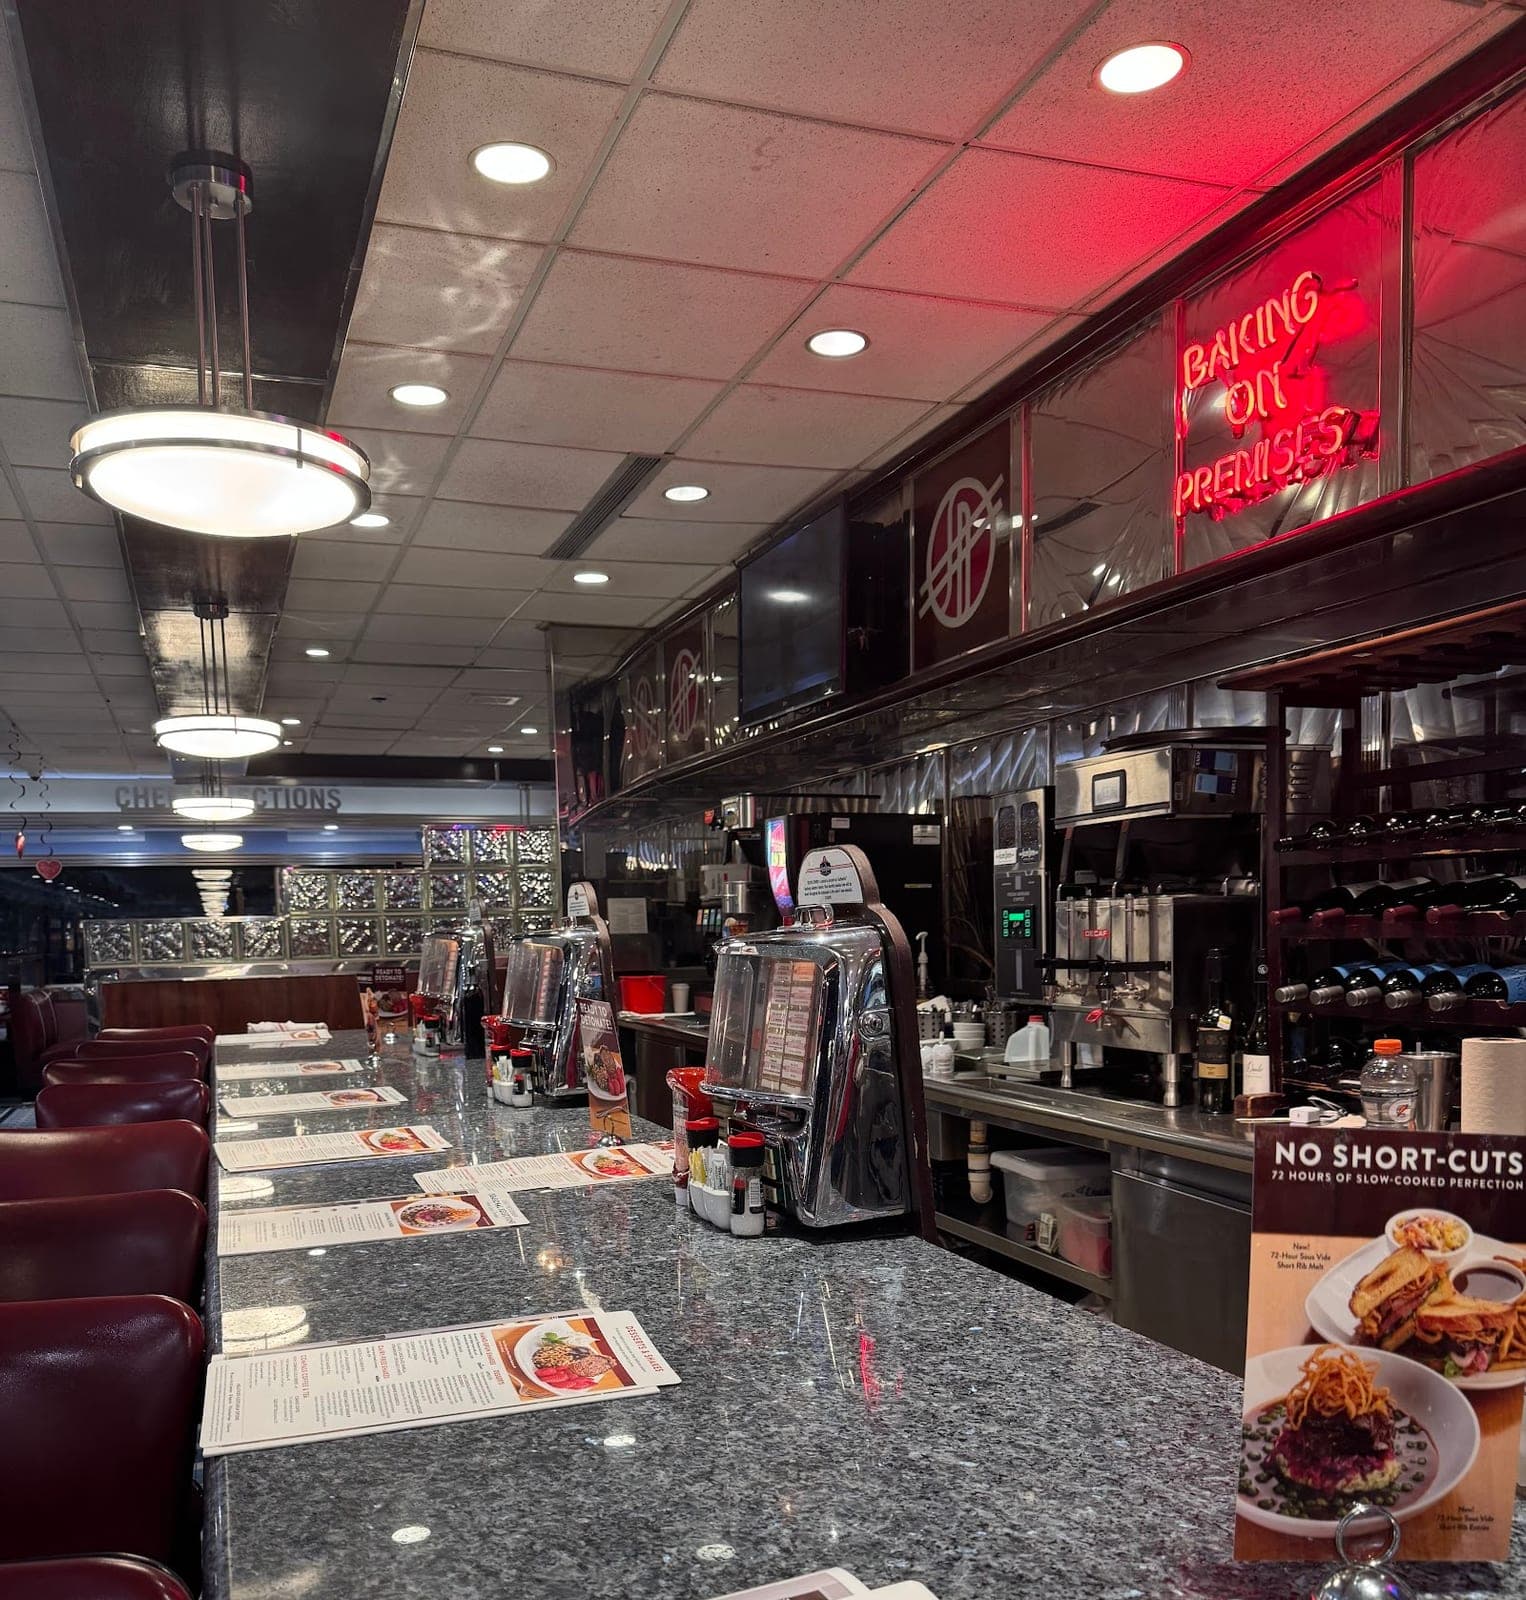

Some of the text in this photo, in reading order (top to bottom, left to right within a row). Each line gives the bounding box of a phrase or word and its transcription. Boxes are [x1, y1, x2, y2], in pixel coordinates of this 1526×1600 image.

[1184, 271, 1322, 389] BAKING
[1225, 361, 1287, 425] ON
[1175, 406, 1350, 516] PREMISES
[115, 785, 173, 809] CHE
[597, 1005, 607, 1017] TO
[580, 1014, 613, 1030] DETONATE!
[1274, 1141, 1524, 1176] NO SHORT-CUTS
[1271, 1170, 1524, 1190] 72 HOURS OF SLOW-COOKED PERFECTION
[1270, 1251, 1331, 1261] 72-Hour Sous Vide
[1292, 1242, 1311, 1250] New!
[1277, 1261, 1324, 1270] Short Rib Melt
